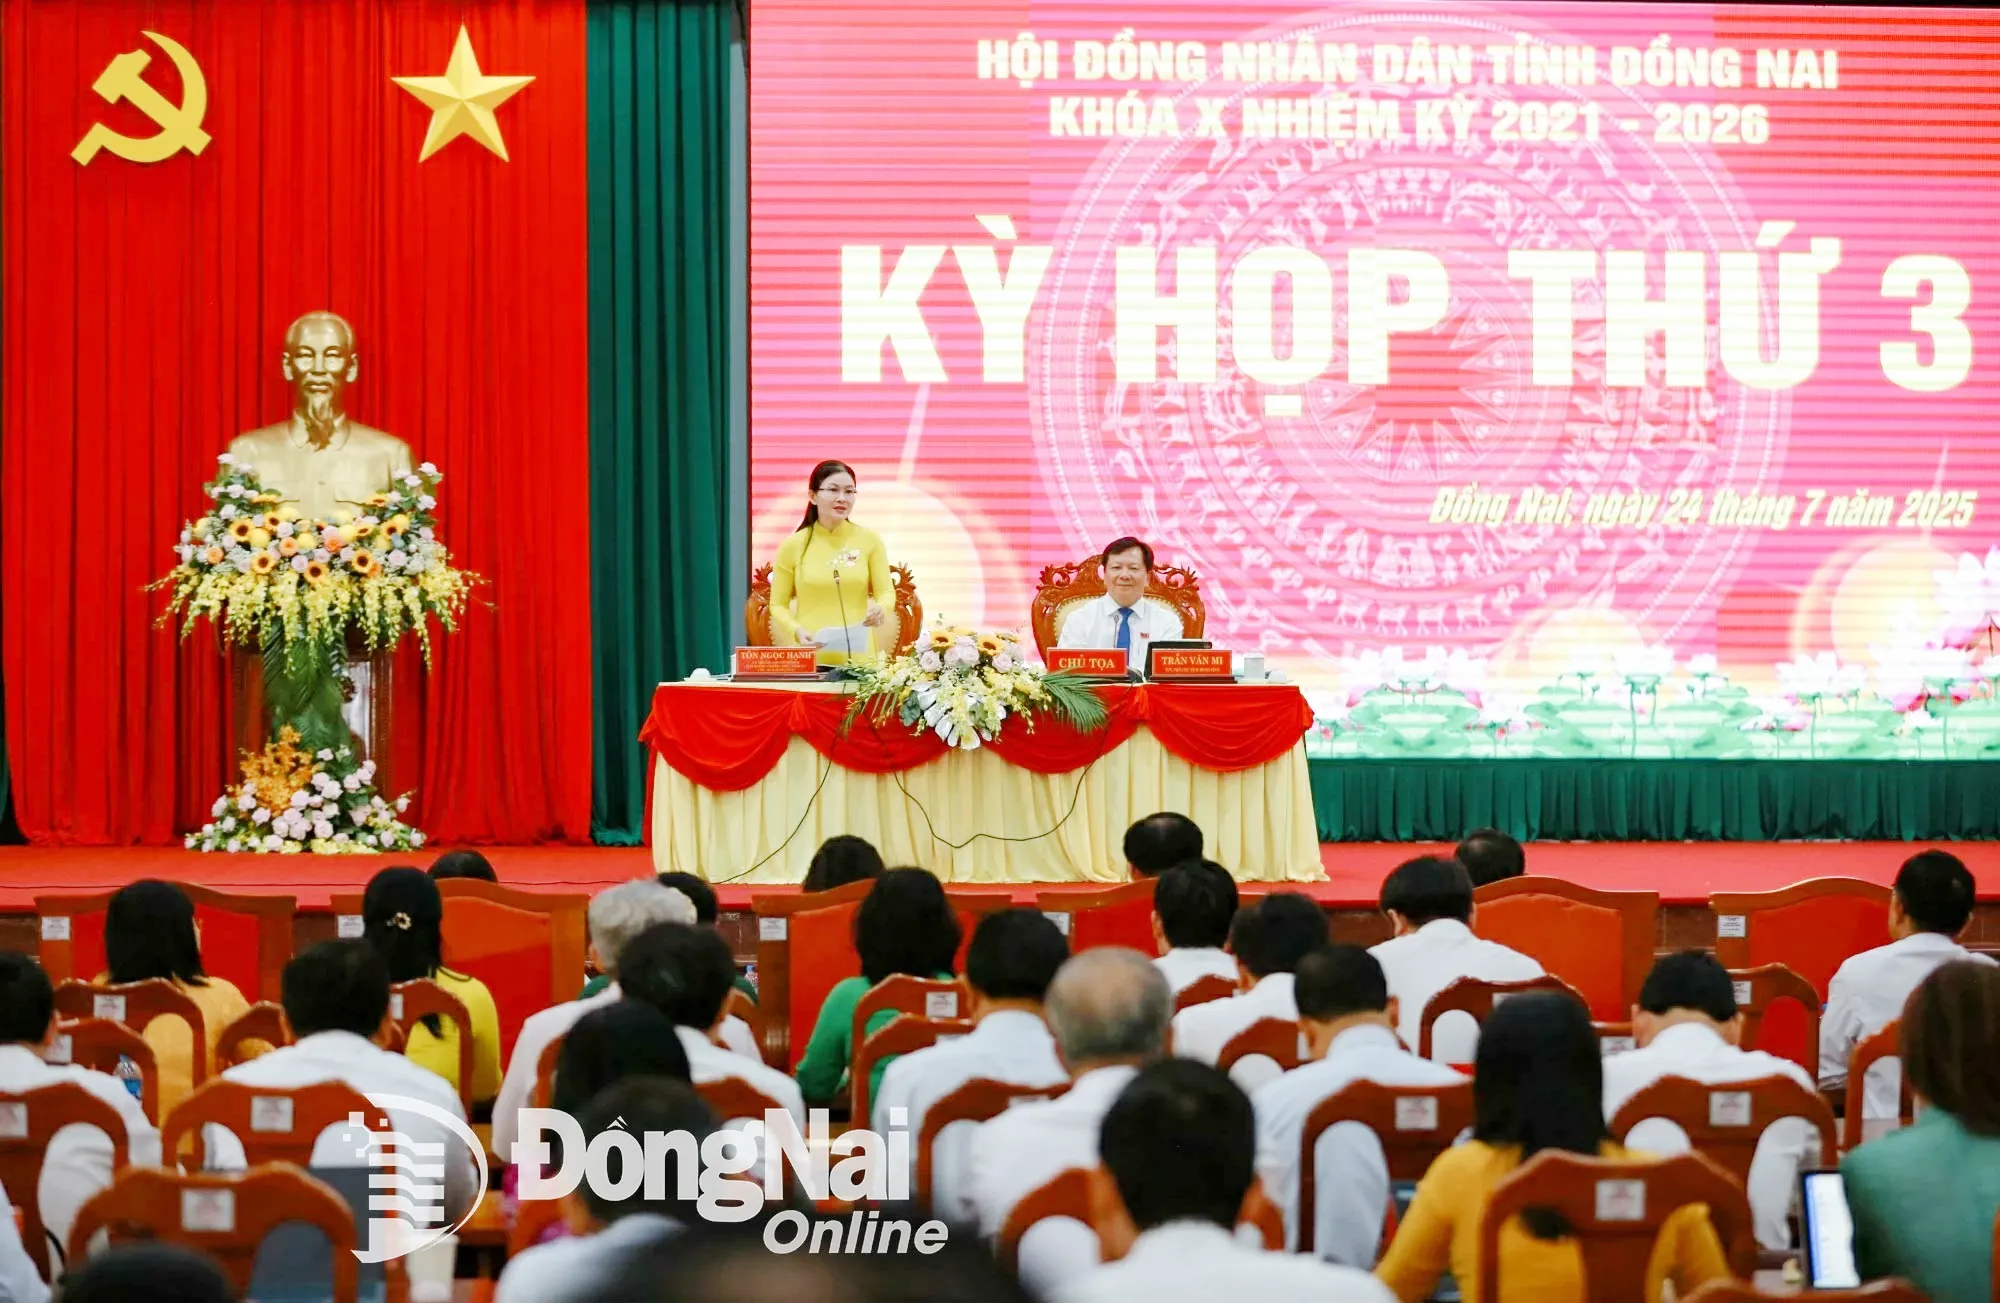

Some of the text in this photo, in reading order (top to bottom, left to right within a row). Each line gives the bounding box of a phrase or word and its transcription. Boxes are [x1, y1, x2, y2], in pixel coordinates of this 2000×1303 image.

[978, 27, 1839, 89] HỘI ĐỒNG NHÂN DÂN TỈNH ĐỒNG NAI
[1049, 89, 1181, 138] KHÓA
[1195, 97, 1228, 138] X
[1242, 91, 1400, 148] NHIỆM
[1415, 92, 1474, 144] KỲ
[1492, 101, 1602, 142] 2021
[1653, 103, 1771, 145] 2026
[840, 214, 1974, 417] KỲ HỌP THỨ 3
[1428, 481, 1979, 531] Đồng Nai, ngày 24 tháng 7 năm 2025
[742, 651, 758, 660] TÔN
[760, 651, 785, 661] NGỌC
[1058, 654, 1116, 672] CHỦ TỌA
[1189, 654, 1209, 665] VĂN
[1211, 656, 1224, 665] MI
